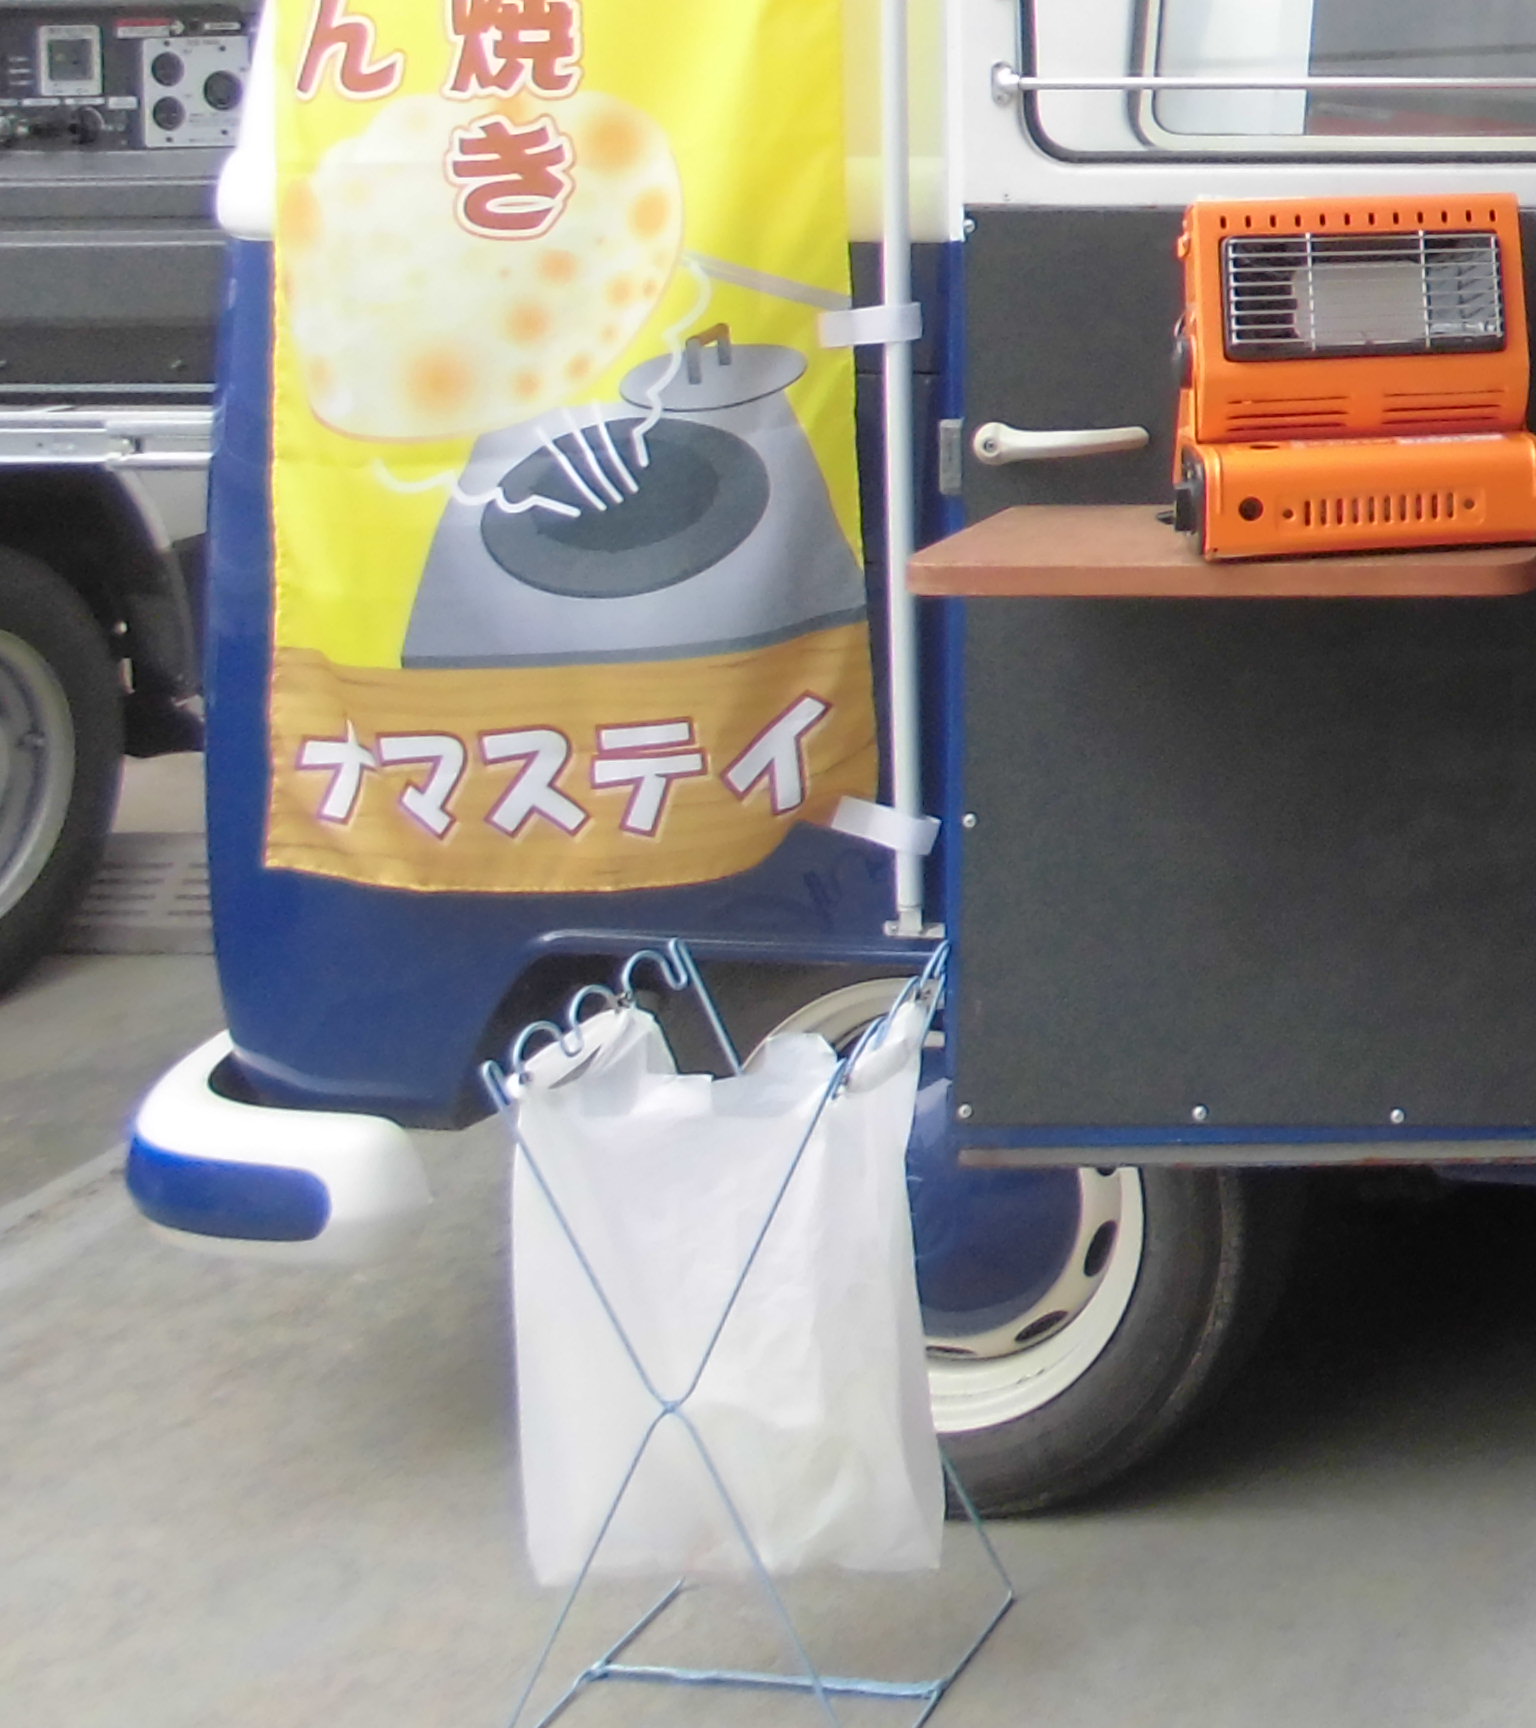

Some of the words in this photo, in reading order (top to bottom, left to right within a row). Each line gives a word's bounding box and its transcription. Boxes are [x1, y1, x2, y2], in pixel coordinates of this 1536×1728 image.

[296, 688, 834, 839] ナマステイ
